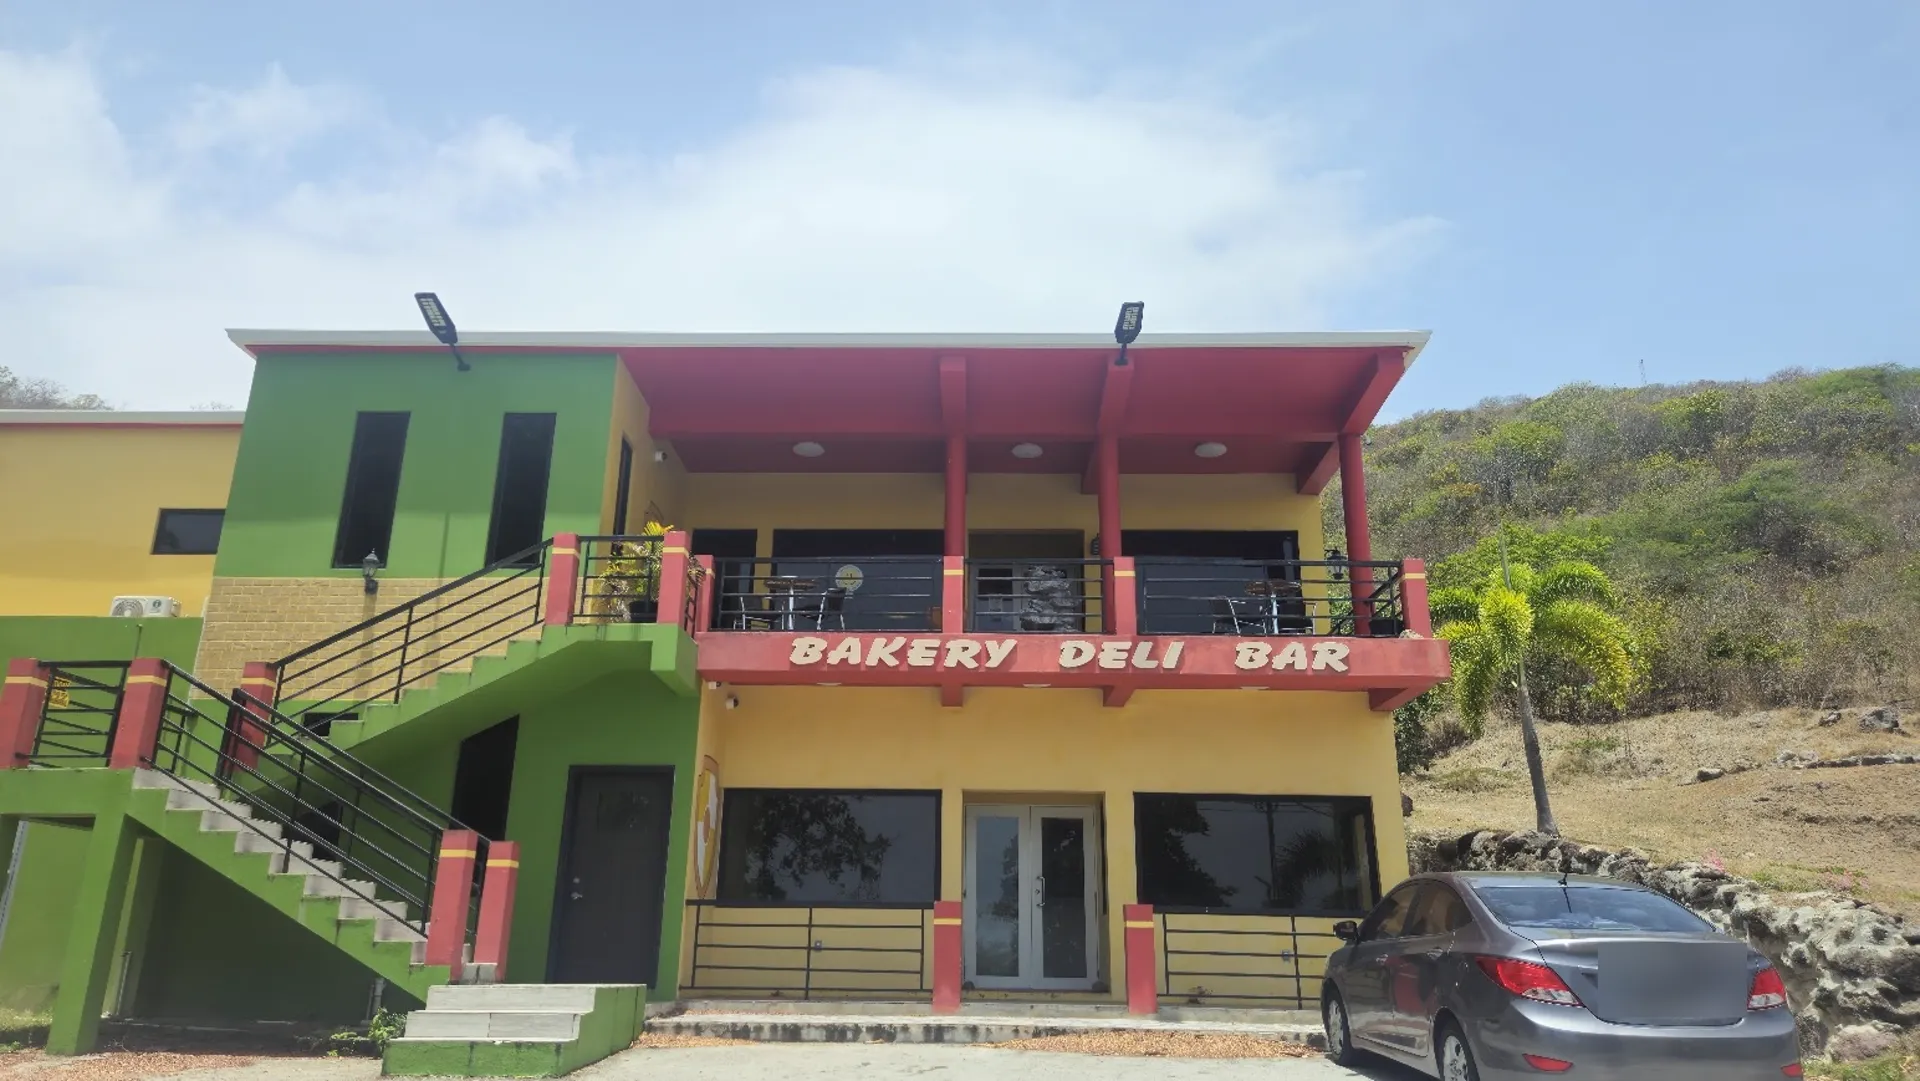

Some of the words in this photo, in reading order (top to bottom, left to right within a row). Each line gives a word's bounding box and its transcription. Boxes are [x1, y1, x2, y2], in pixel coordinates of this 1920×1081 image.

[789, 636, 1017, 668] BAKERY
[1058, 640, 1184, 669] DELI
[1235, 641, 1349, 672] BAR
